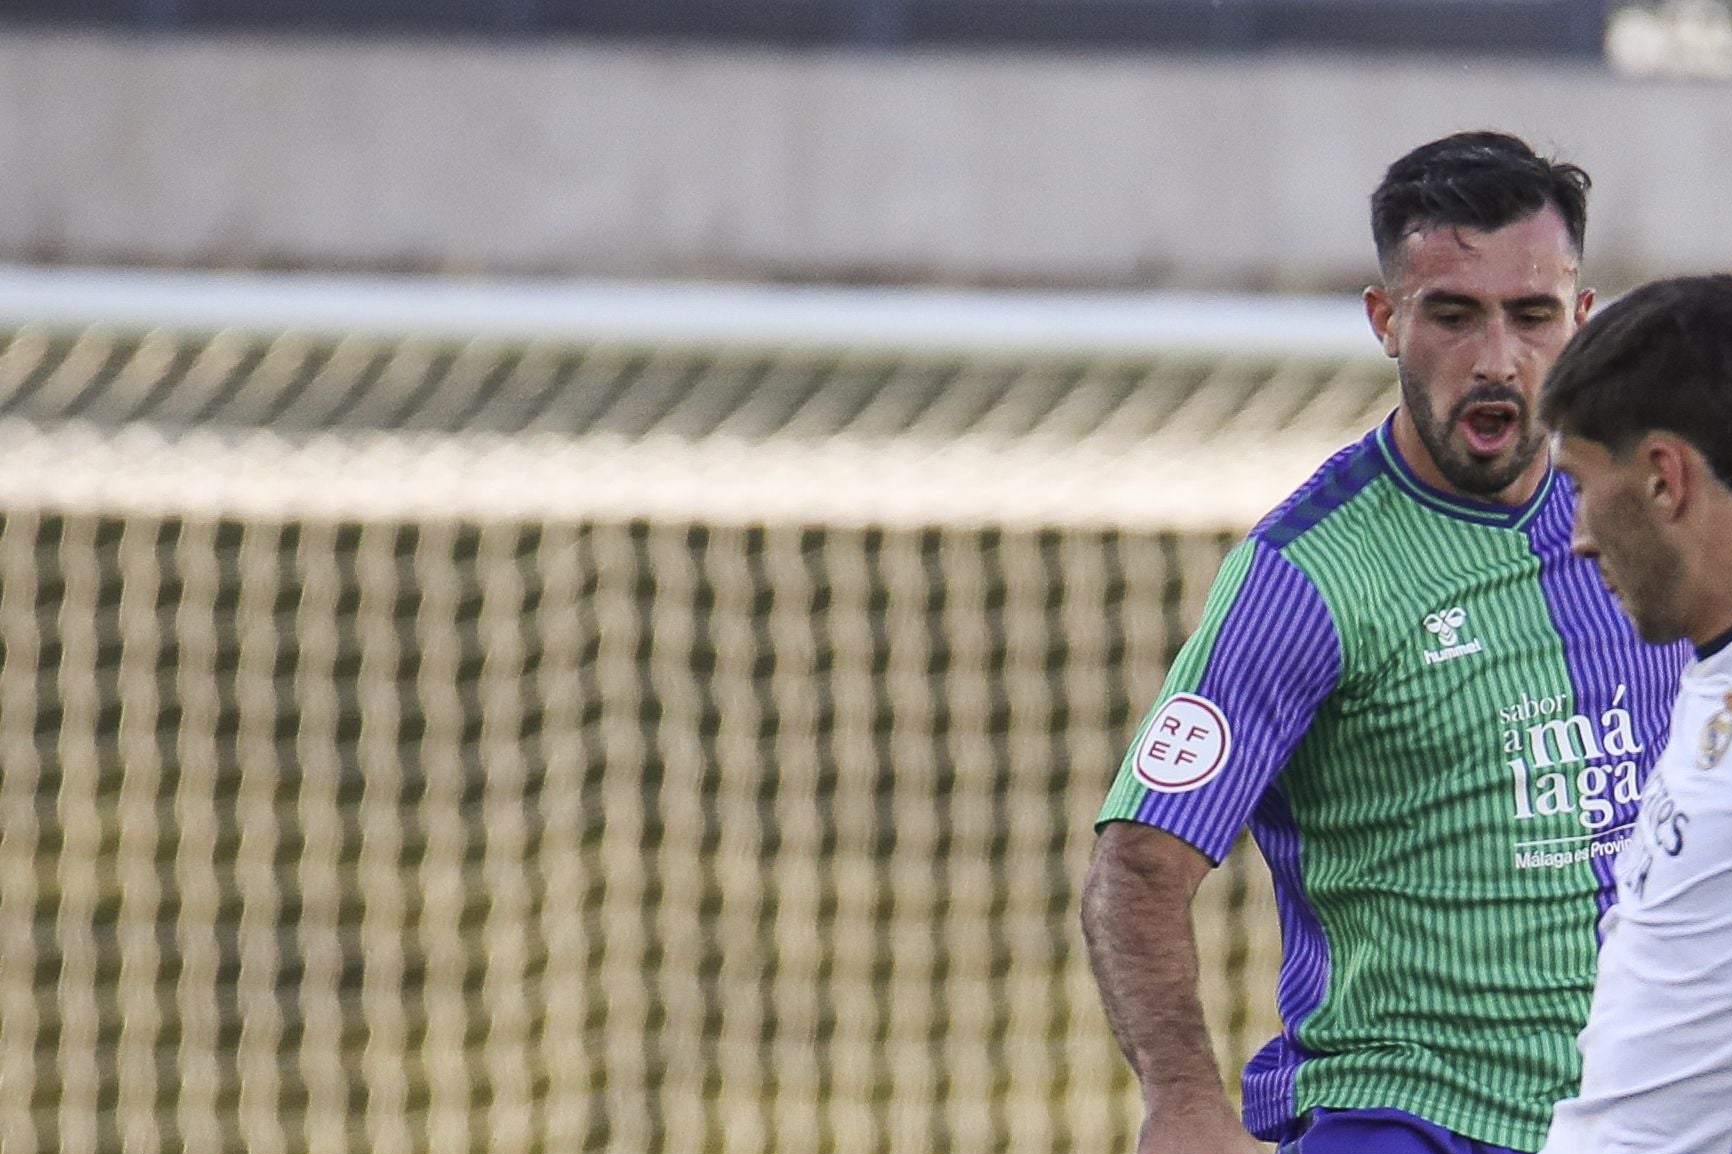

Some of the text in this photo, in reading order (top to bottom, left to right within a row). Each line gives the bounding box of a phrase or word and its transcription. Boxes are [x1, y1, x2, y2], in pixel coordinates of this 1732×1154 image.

[1424, 638, 1481, 664] hummel
[1500, 693, 1567, 725] sabor
[1503, 684, 1643, 769] a má
[1507, 757, 1643, 829] laga
[1514, 849, 1573, 869] Málaga
[1574, 847, 1590, 862] es
